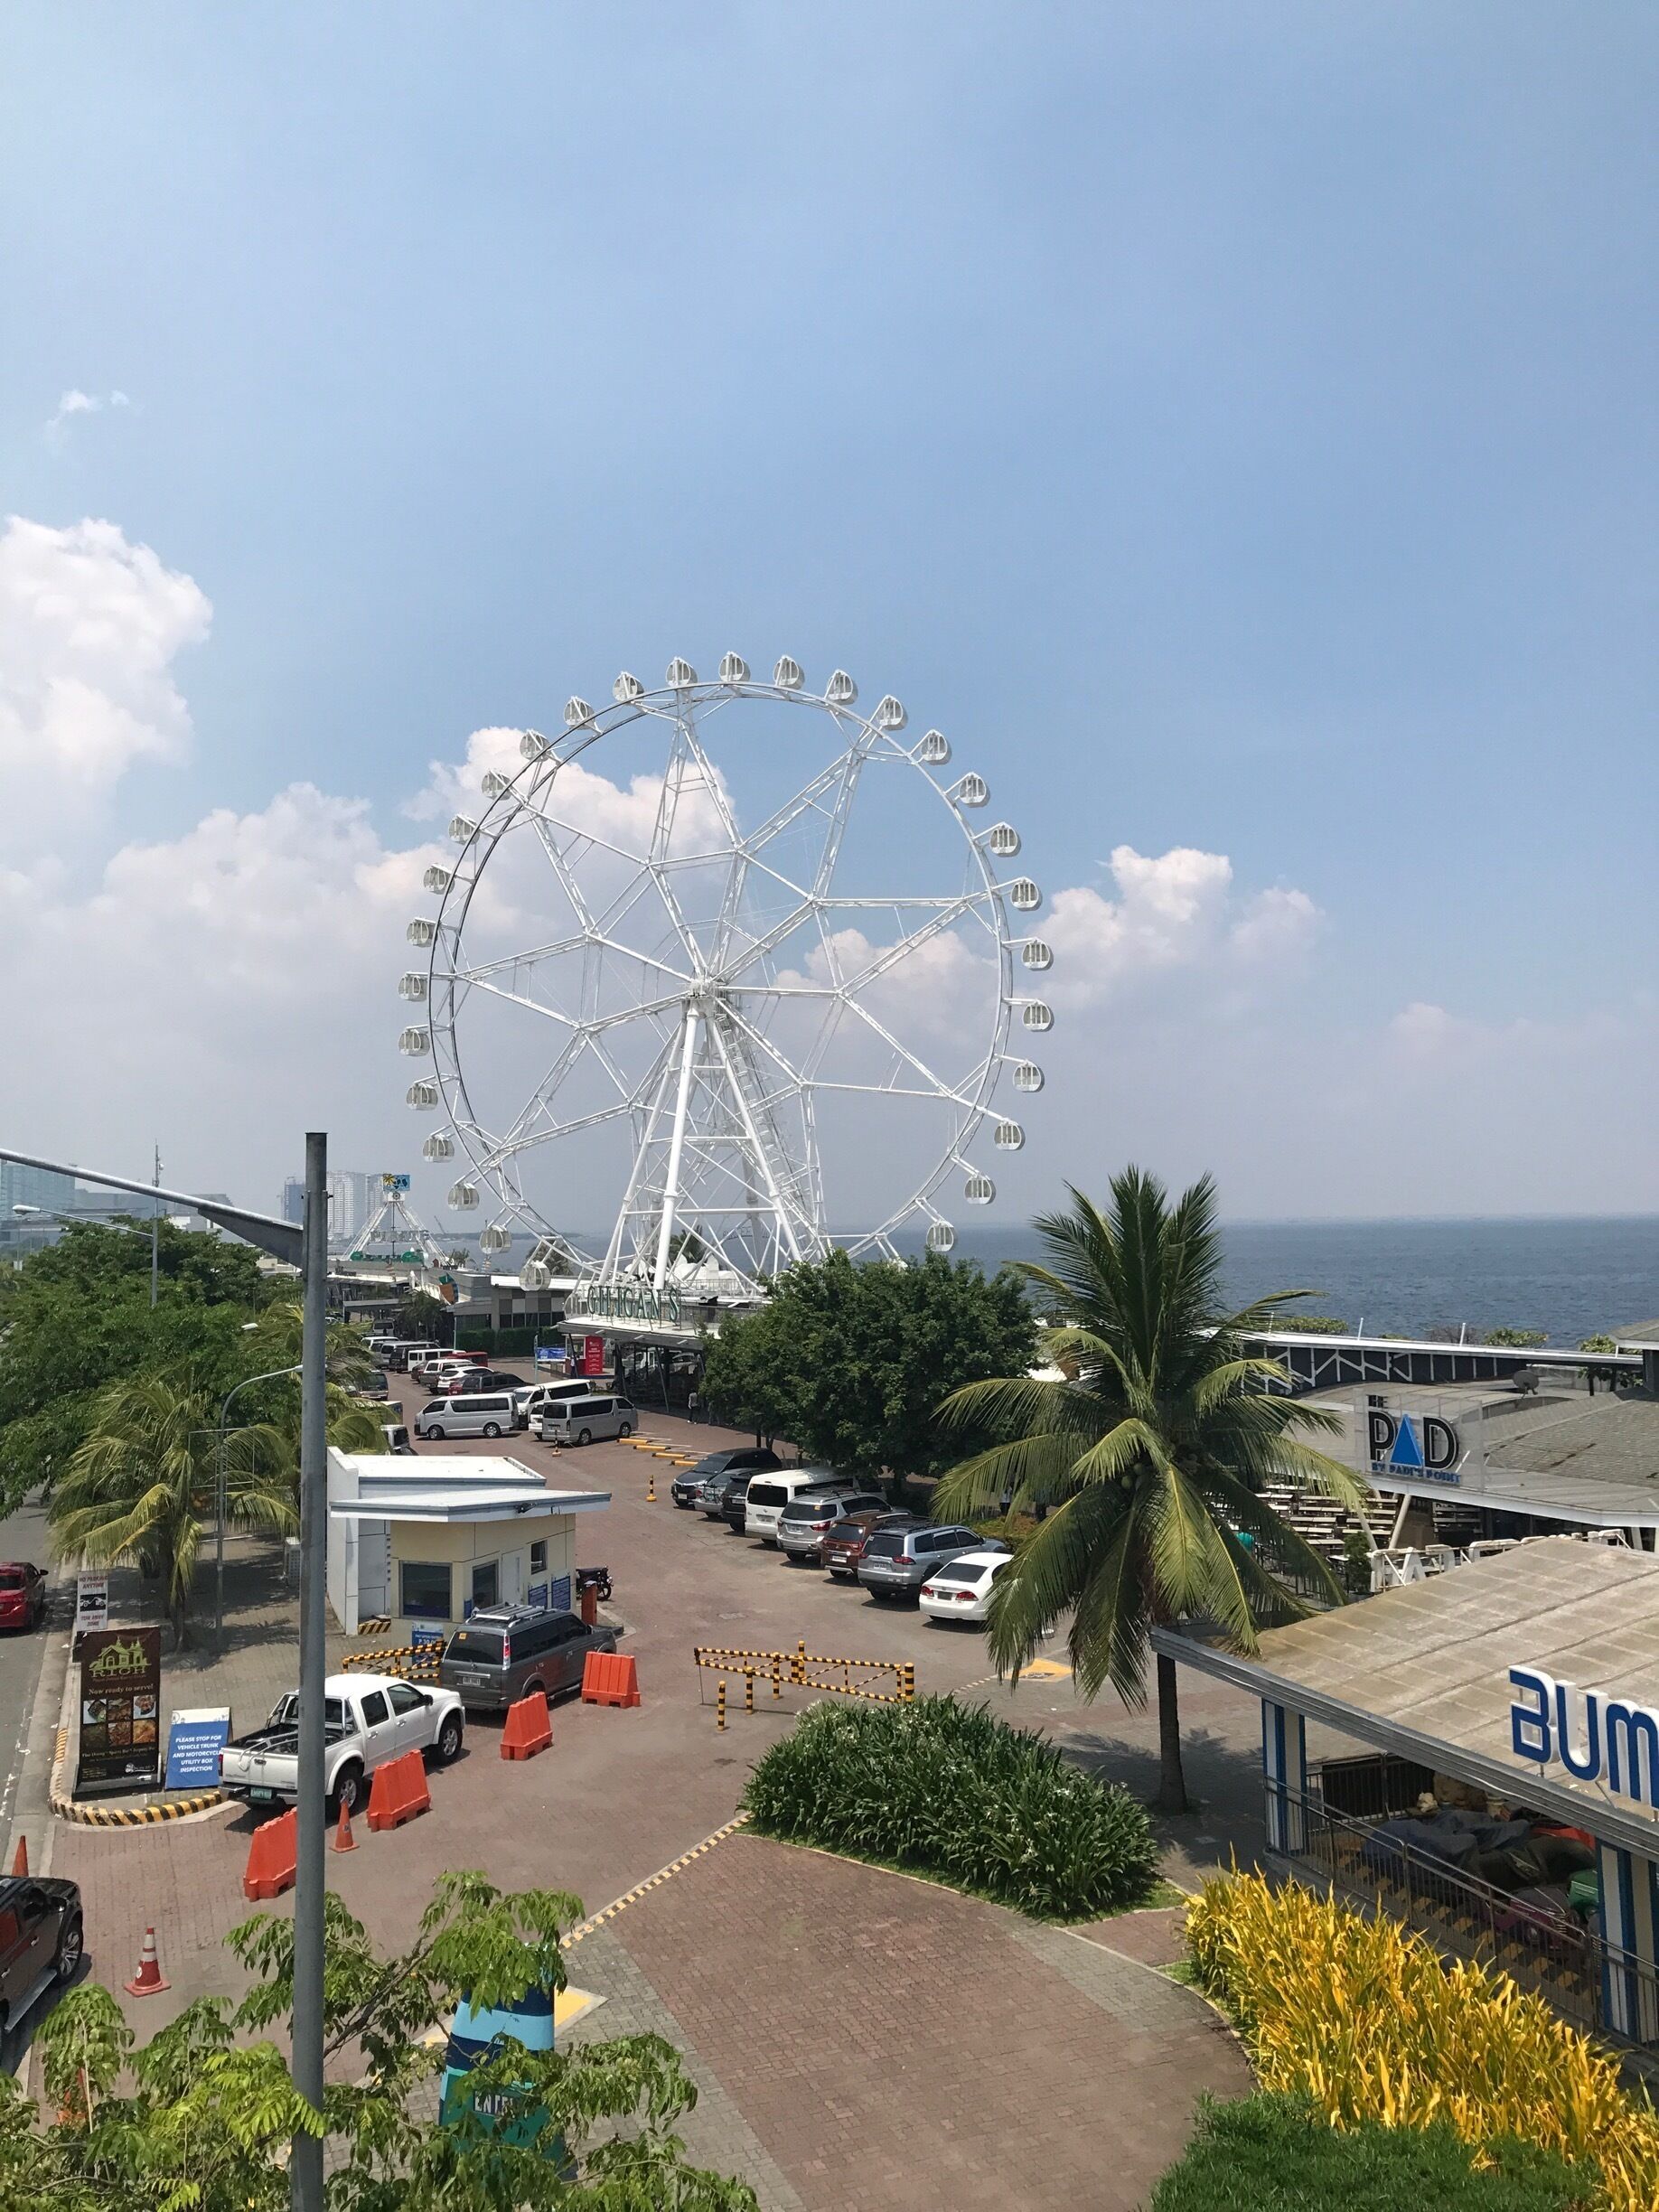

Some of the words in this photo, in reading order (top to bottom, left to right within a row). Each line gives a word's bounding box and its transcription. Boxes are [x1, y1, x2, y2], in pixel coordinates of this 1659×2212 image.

[1368, 1411, 1459, 1470] PAD
[91, 1666, 145, 1678] RICH
[105, 1686, 124, 1694] ready
